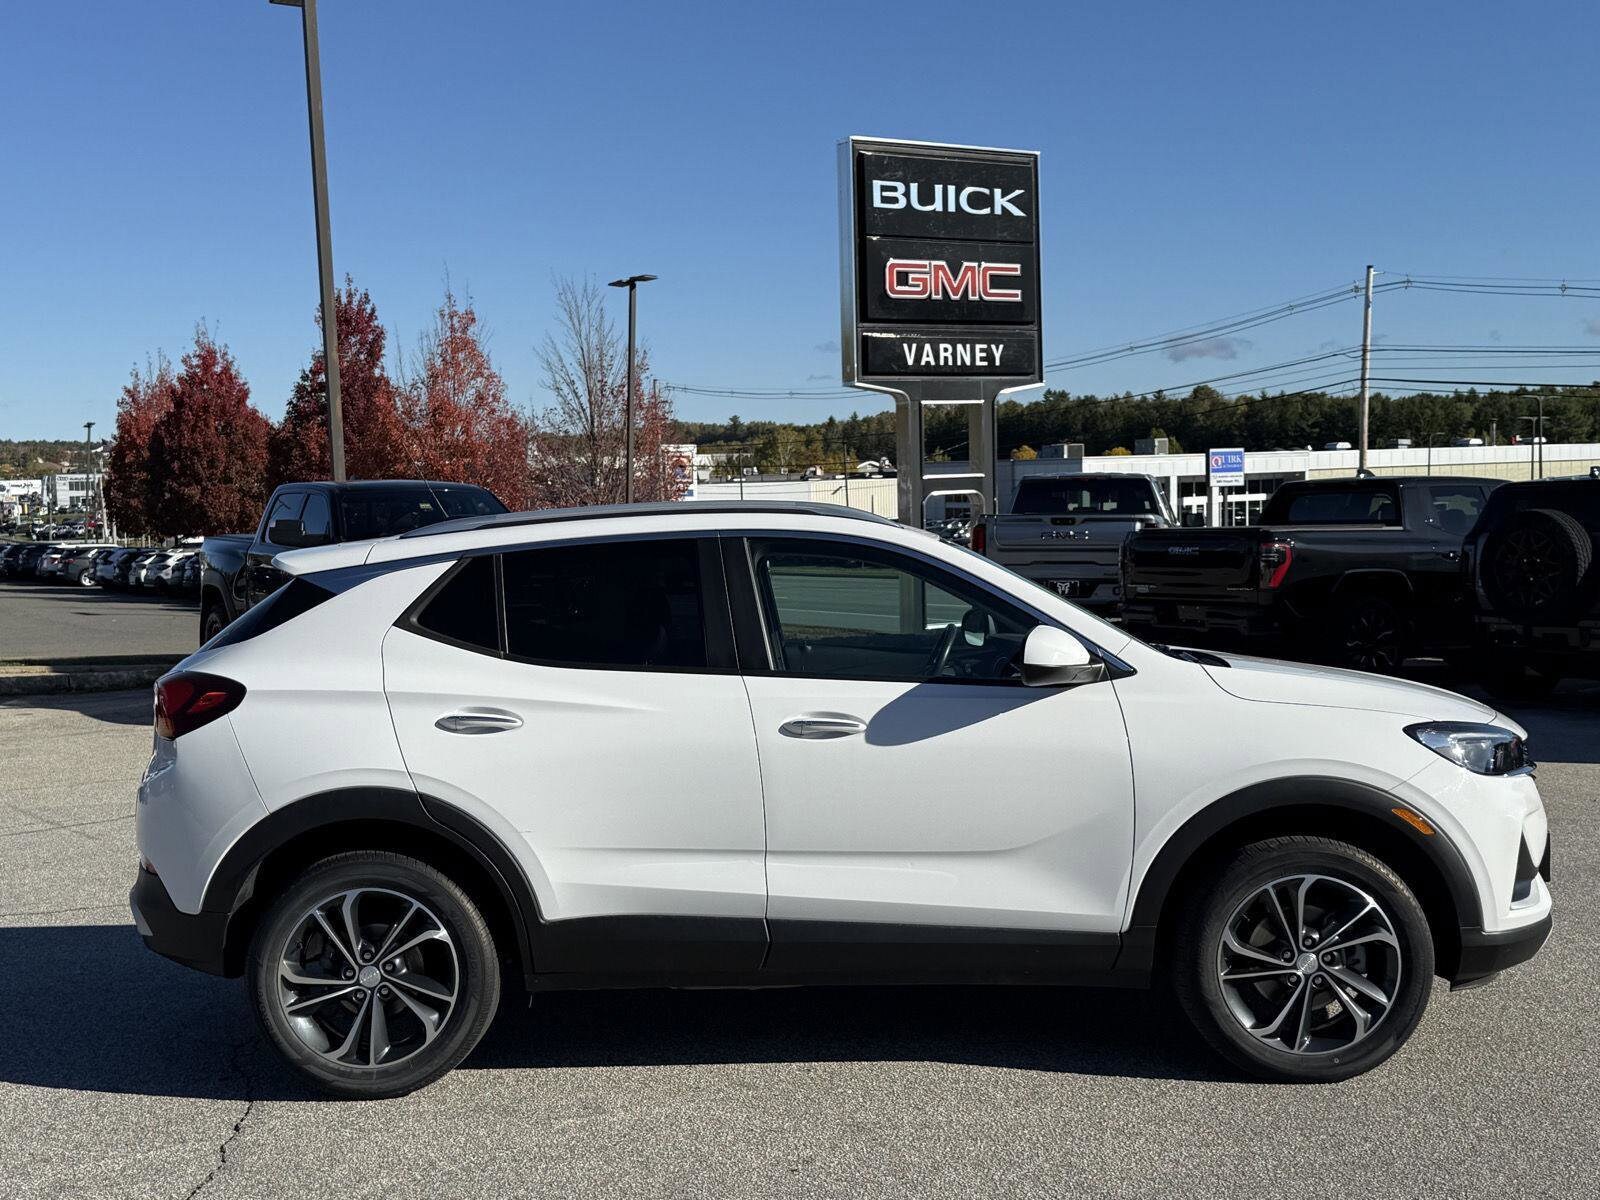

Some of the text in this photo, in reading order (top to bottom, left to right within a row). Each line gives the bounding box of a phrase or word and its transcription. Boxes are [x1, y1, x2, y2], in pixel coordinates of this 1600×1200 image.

[872, 179, 1027, 217] BUICK
[885, 257, 1022, 302] GMC
[902, 343, 1004, 367] VARNEY
